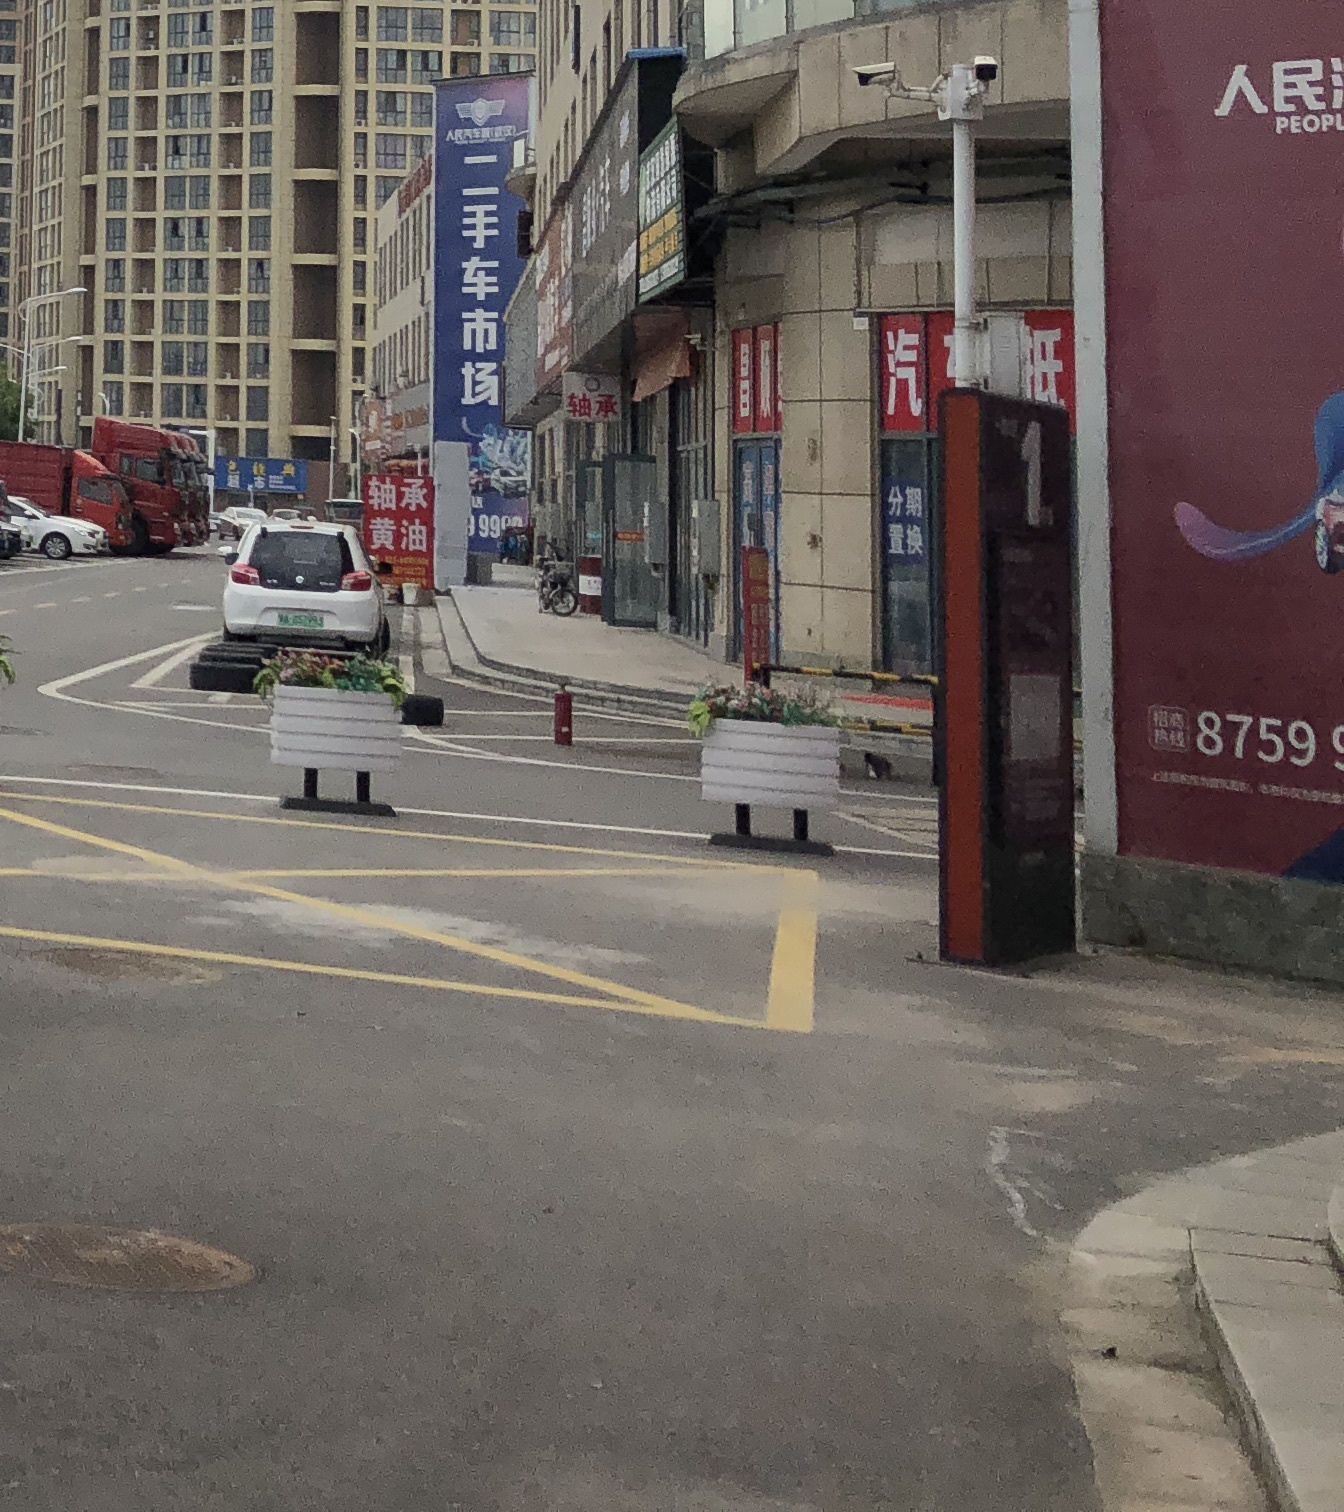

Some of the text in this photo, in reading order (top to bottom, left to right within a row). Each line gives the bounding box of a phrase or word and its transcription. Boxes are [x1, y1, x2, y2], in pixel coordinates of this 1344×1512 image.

[1214, 57, 1344, 116] 人民
[461, 154, 500, 406] 二手车市场
[567, 393, 618, 418] 轴承
[368, 476, 428, 511] 轴承
[888, 484, 923, 518] 分期
[369, 517, 428, 552] 黄油
[888, 523, 924, 556] 置换
[1196, 710, 1317, 767] 8759
